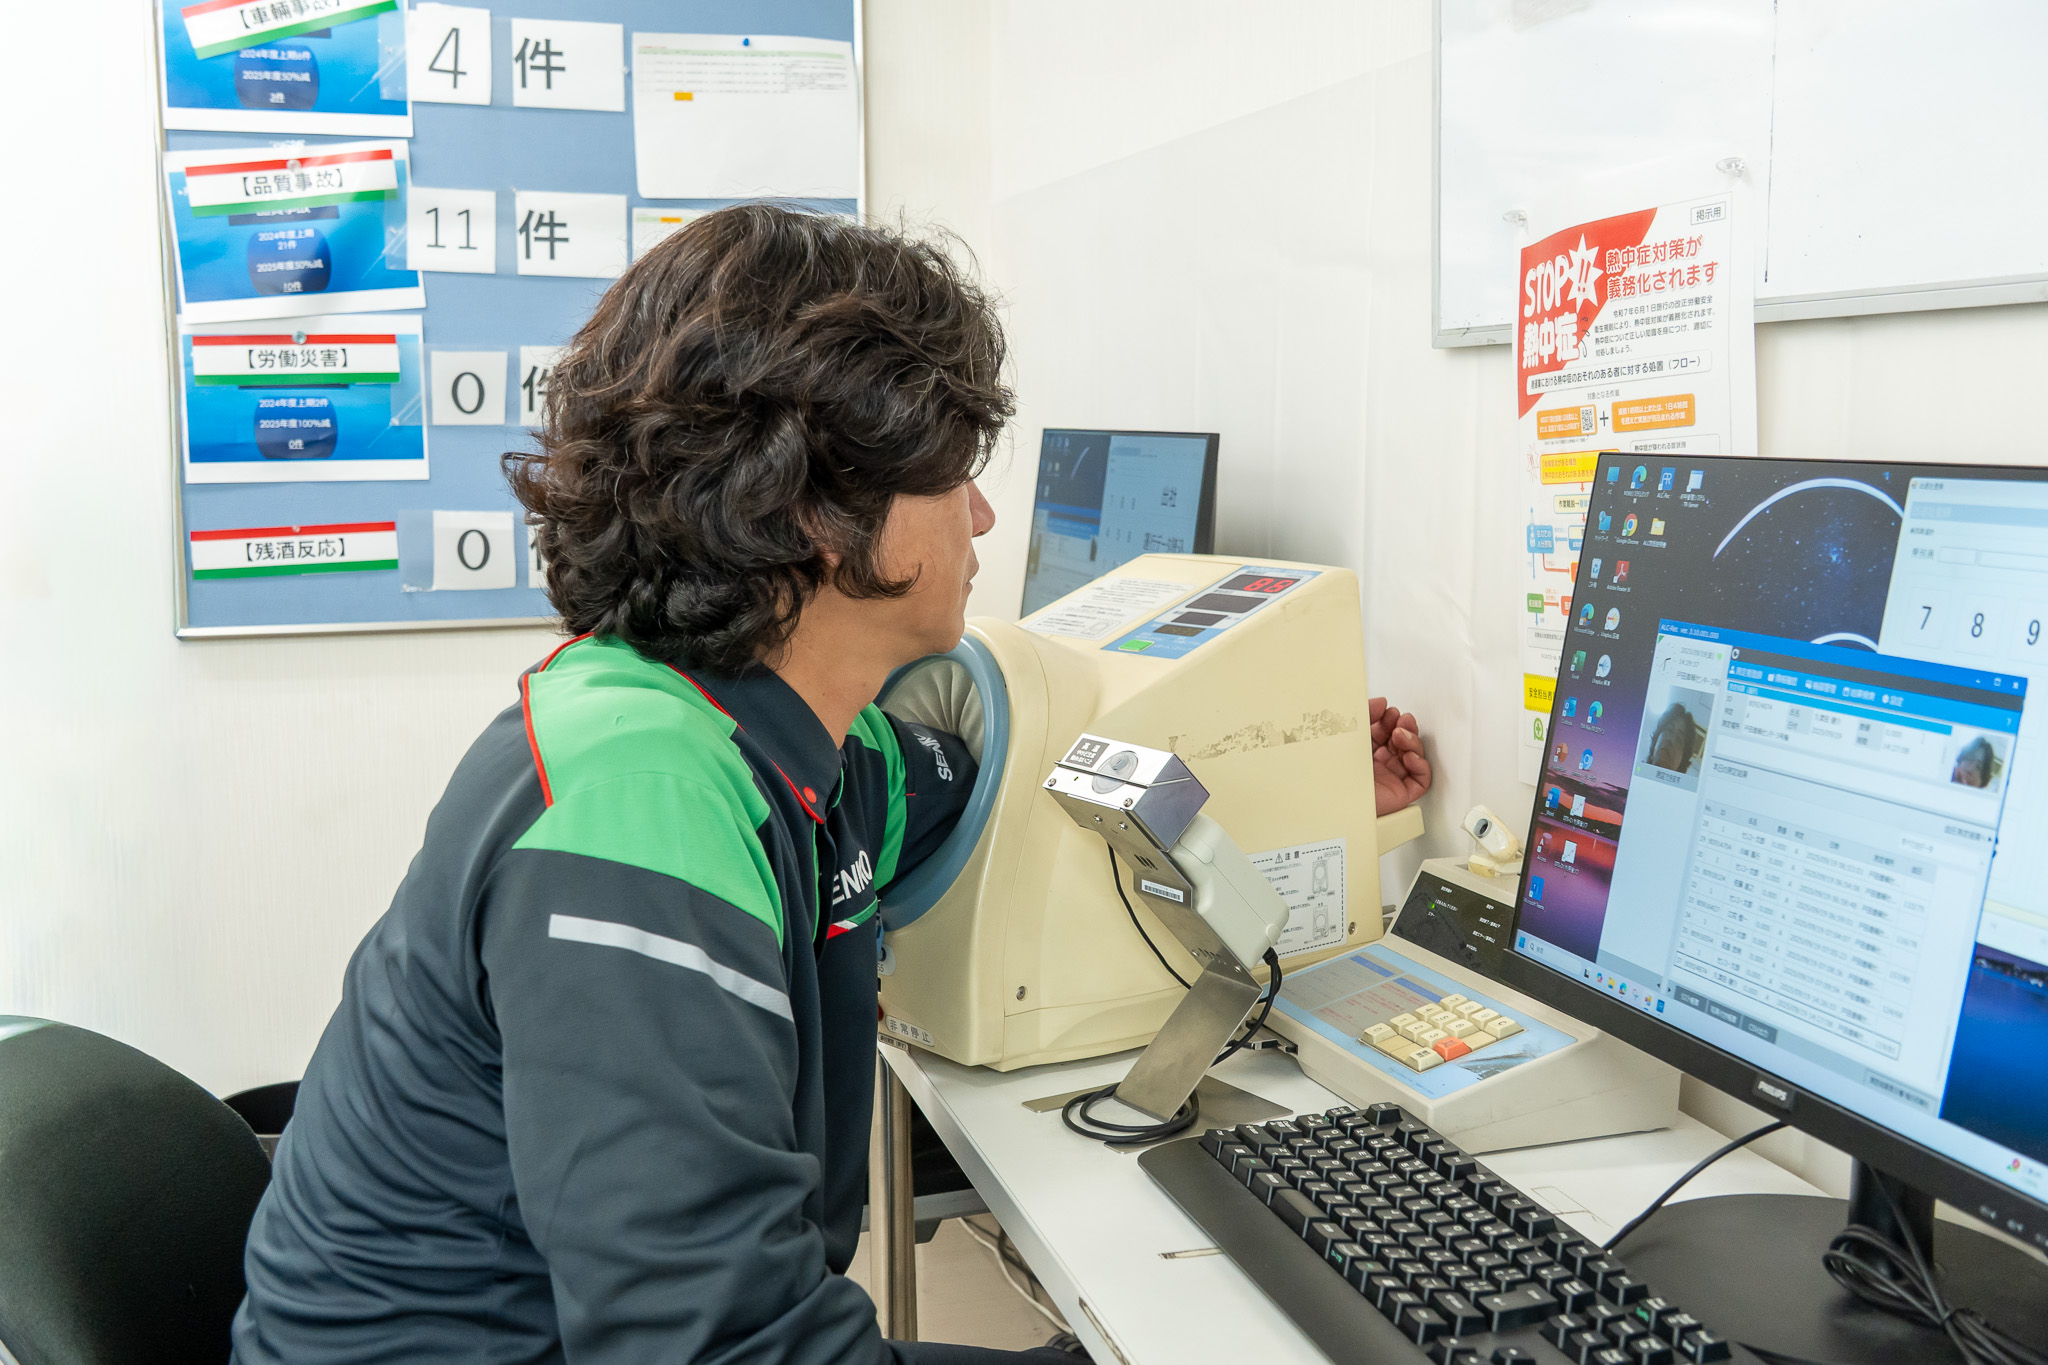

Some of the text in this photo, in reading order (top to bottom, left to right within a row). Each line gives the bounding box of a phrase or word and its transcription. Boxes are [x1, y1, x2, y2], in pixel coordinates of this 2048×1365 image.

[428, 27, 467, 89] 4
[514, 37, 566, 90] 件
[242, 168, 343, 196] 【品質事故】
[425, 207, 478, 250] 11
[1695, 206, 1722, 222] 掲示用
[518, 210, 570, 260] 件
[1606, 234, 1704, 275] 熱中症対策が
[1523, 254, 1571, 318] STOP
[1607, 261, 1719, 300] 義務化されます
[1522, 311, 1581, 370] 熱中症
[248, 348, 349, 369] 【労働災害】
[245, 538, 347, 563] 【残酒反応】
[1920, 605, 1932, 631] 7
[1971, 612, 1985, 638] 8
[2027, 619, 2041, 646] 9
[889, 1019, 931, 1044] 非常停止
